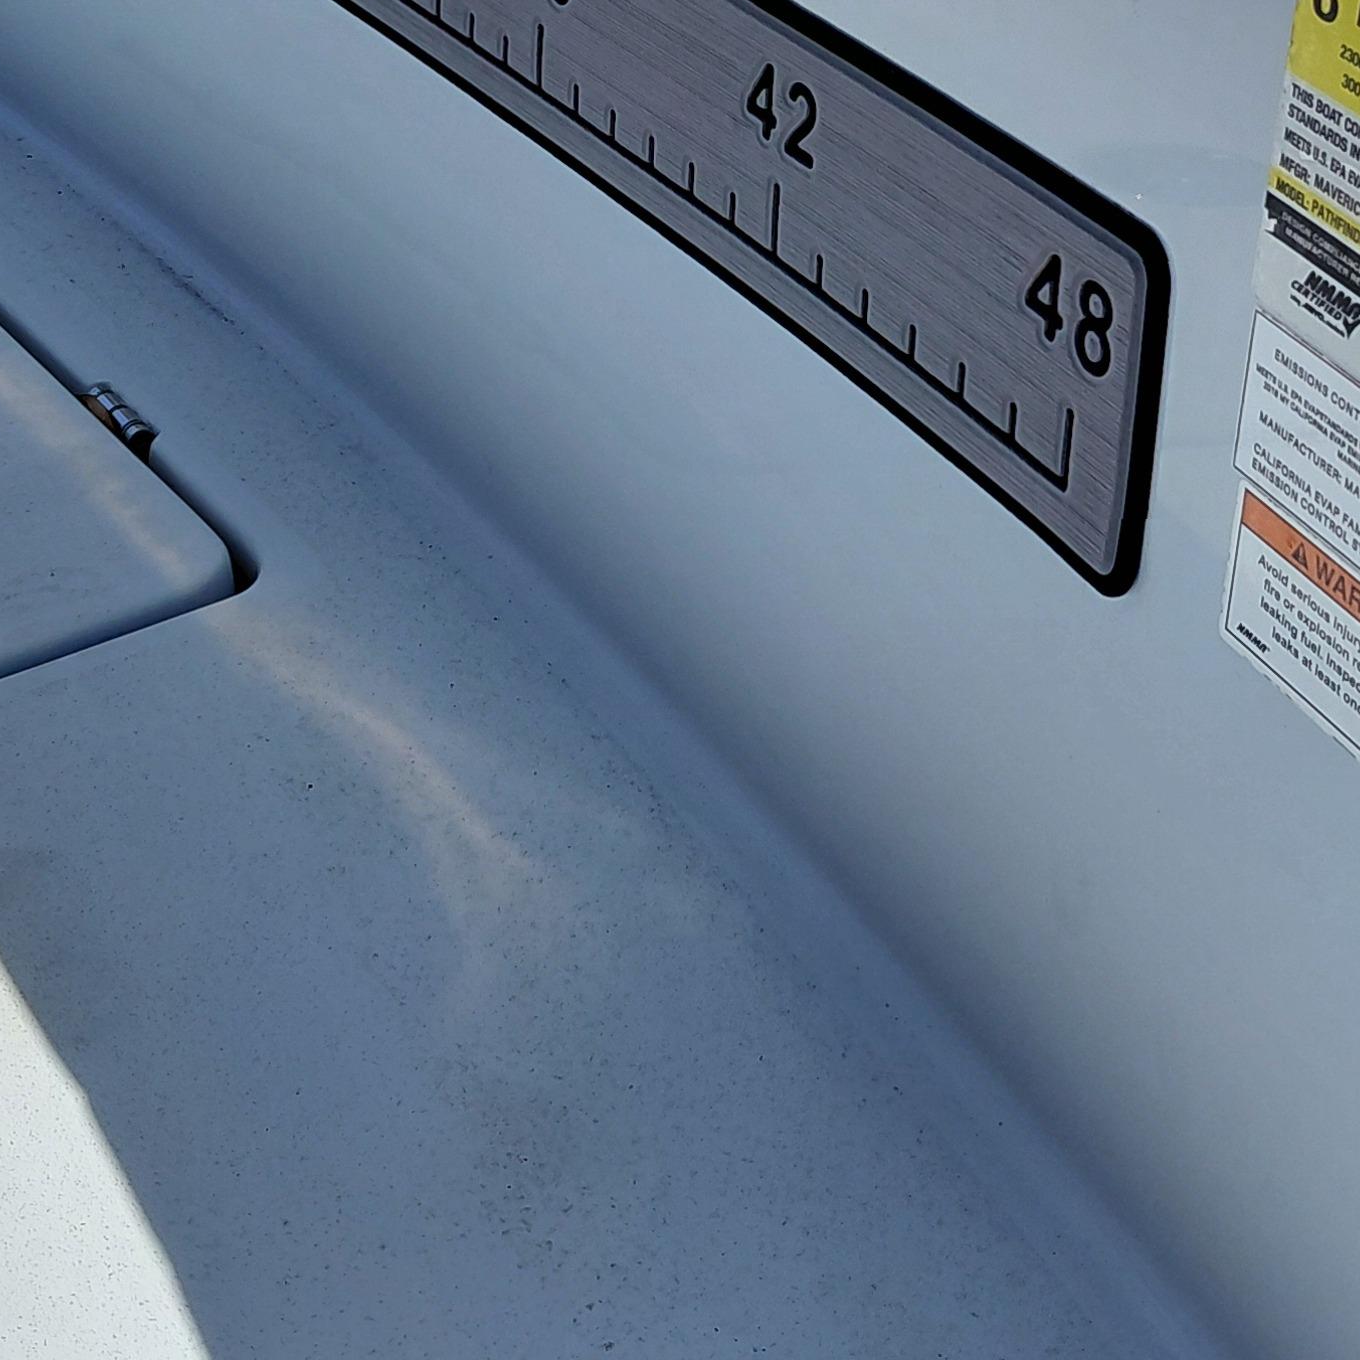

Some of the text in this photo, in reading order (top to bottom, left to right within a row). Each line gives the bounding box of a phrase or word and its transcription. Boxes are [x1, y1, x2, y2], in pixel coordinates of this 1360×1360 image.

[745, 63, 819, 170] 42
[1287, 101, 1348, 153] STANDARDS
[1349, 142, 1360, 162] IN
[1290, 82, 1314, 110] THIS
[1314, 97, 1343, 128] BOAT
[1278, 151, 1311, 186] MFGR:
[1283, 125, 1311, 156] MEETS
[1312, 144, 1329, 168] U.S.
[1329, 156, 1347, 180] EPA
[1274, 175, 1310, 211] MODEL:
[1024, 254, 1114, 378] 48
[1291, 279, 1343, 321] CERTIFIED
[1273, 347, 1329, 399] EMISSIONS
[1252, 440, 1313, 498] CALIFORNIA
[1313, 489, 1340, 520] EVAP
[1258, 409, 1342, 485] MANUFACTURER:
[1251, 455, 1298, 504] EMISSION
[1299, 494, 1350, 546] CONTROL
[1257, 550, 1289, 588] Avoid
[1289, 578, 1331, 625] serious
[1262, 576, 1281, 603] fire
[1282, 595, 1295, 615] or
[1295, 605, 1350, 665] explosion
[1259, 594, 1298, 641] leaking
[1299, 628, 1325, 661] fuel.
[1271, 624, 1300, 661] leaks
[1301, 652, 1313, 672] at
[1314, 662, 1341, 698] least
